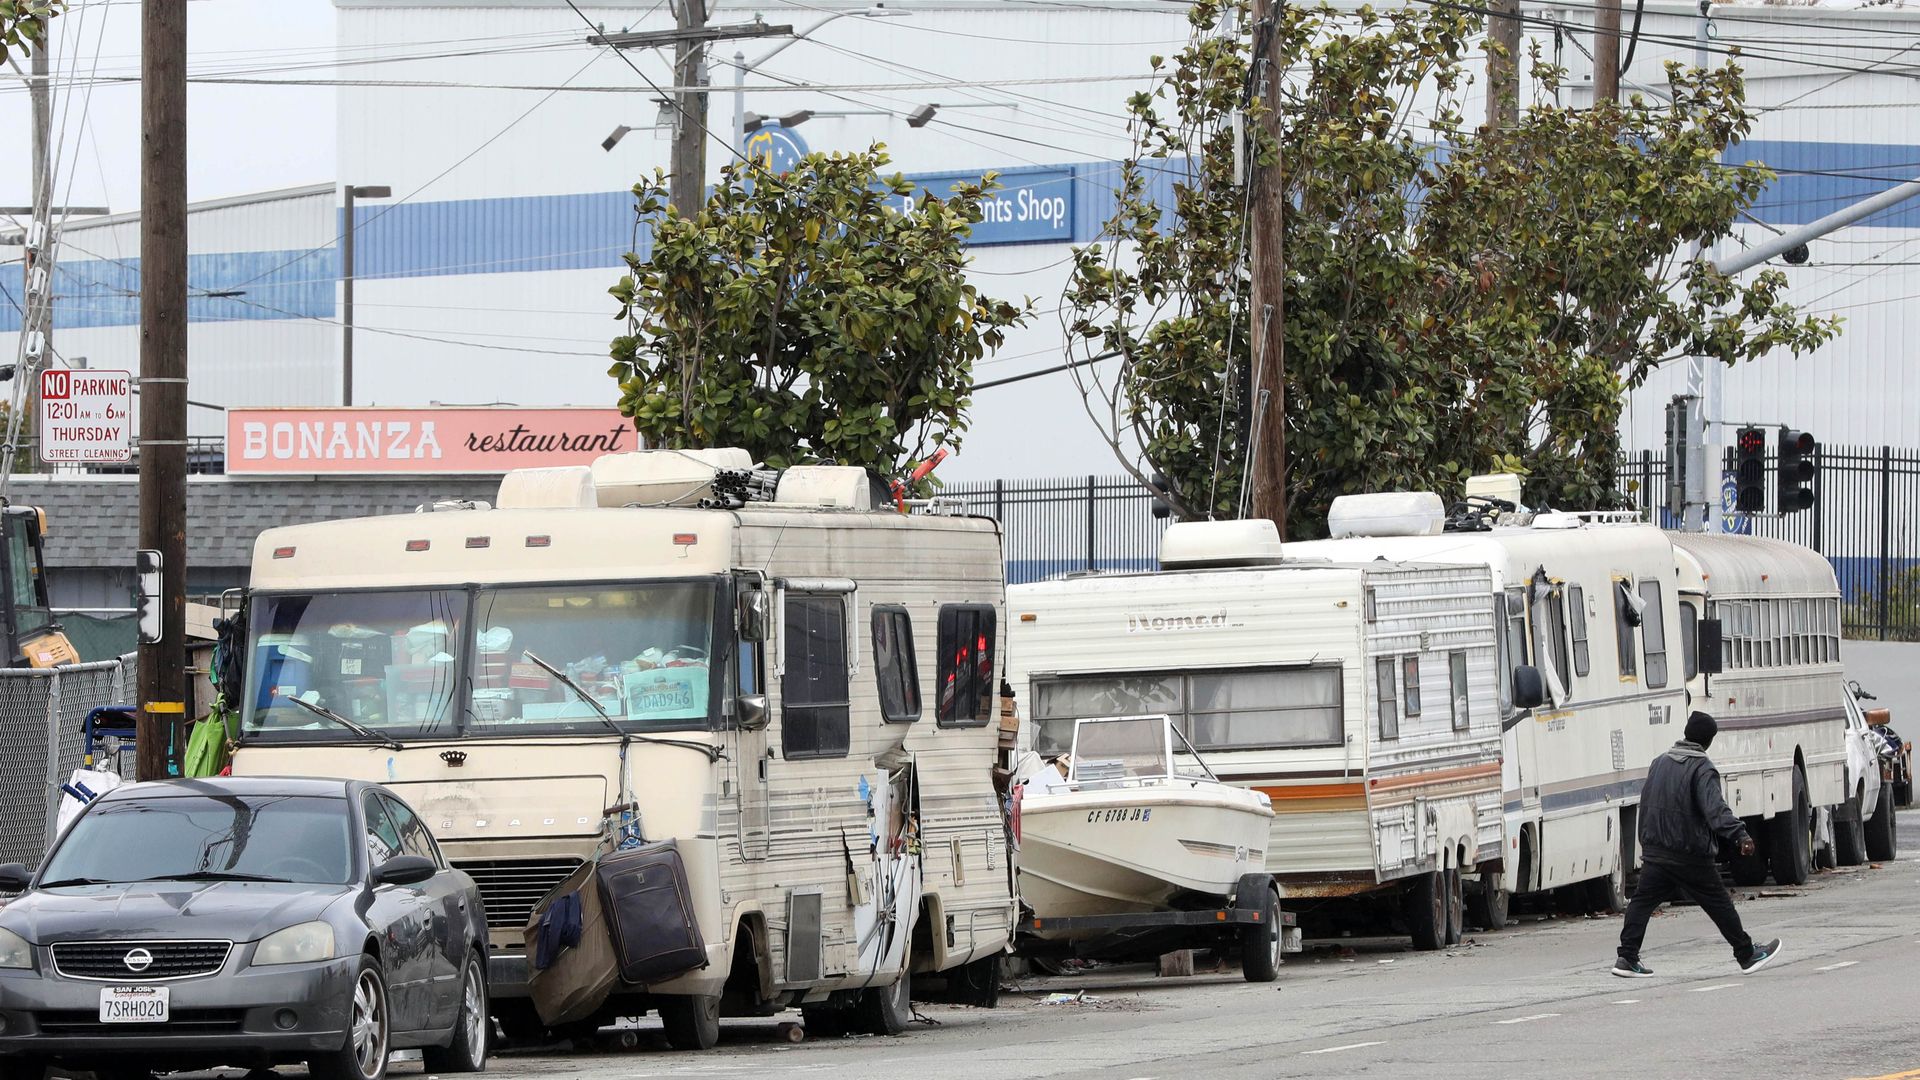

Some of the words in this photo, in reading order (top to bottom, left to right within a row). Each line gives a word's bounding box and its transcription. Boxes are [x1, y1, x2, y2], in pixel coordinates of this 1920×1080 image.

[1018, 189, 1065, 229] Shop
[45, 374, 67, 396] NO
[73, 379, 126, 396] PARKING
[52, 427, 120, 441] THURSDAY
[243, 421, 442, 460] BONANZA
[464, 424, 631, 452] restaurant
[49, 449, 79, 458] STREET
[84, 449, 123, 458] CLEANING
[1127, 607, 1227, 632] Nomad
[1105, 808, 1128, 822] 6788
[1130, 808, 1141, 821] JB
[105, 1000, 164, 1017] 7SRH020
